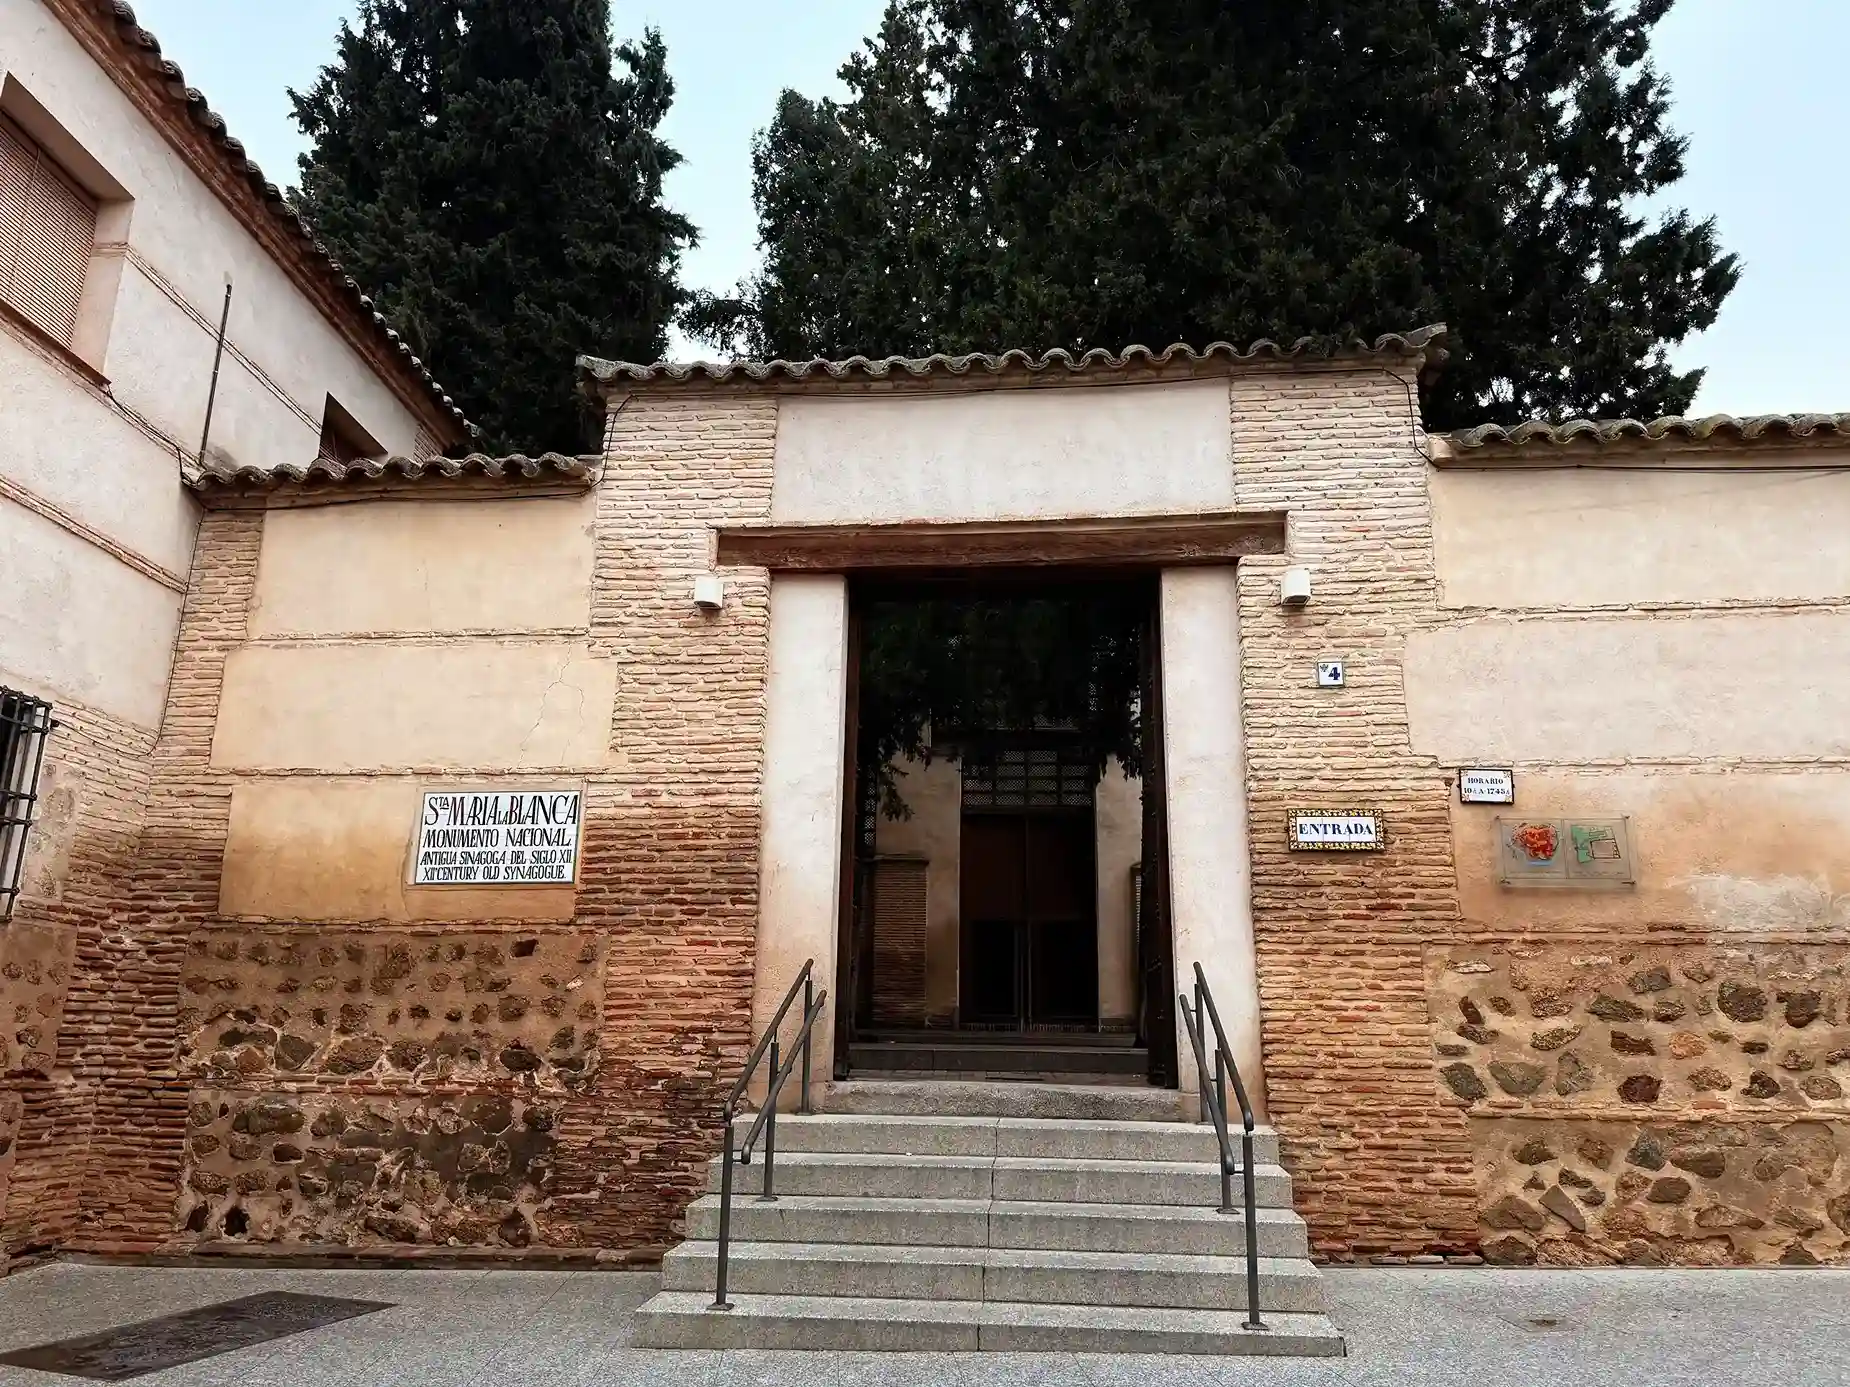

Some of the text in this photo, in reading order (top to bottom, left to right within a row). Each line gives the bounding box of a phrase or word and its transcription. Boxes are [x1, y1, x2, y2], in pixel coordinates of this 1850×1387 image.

[1328, 666, 1341, 681] 4
[1467, 777, 1504, 785] HORARIO
[447, 795, 500, 826] MARIA
[498, 810, 509, 825] LA
[508, 794, 579, 825] BLANCA
[1299, 823, 1373, 835] ENTRADA
[422, 828, 499, 848] MONUMENTO
[420, 850, 457, 866] ANTIGUA
[459, 850, 507, 866] SINAGOGA
[510, 850, 527, 865] DEL
[529, 850, 556, 864] SIGLO
[483, 865, 500, 880] OLD
